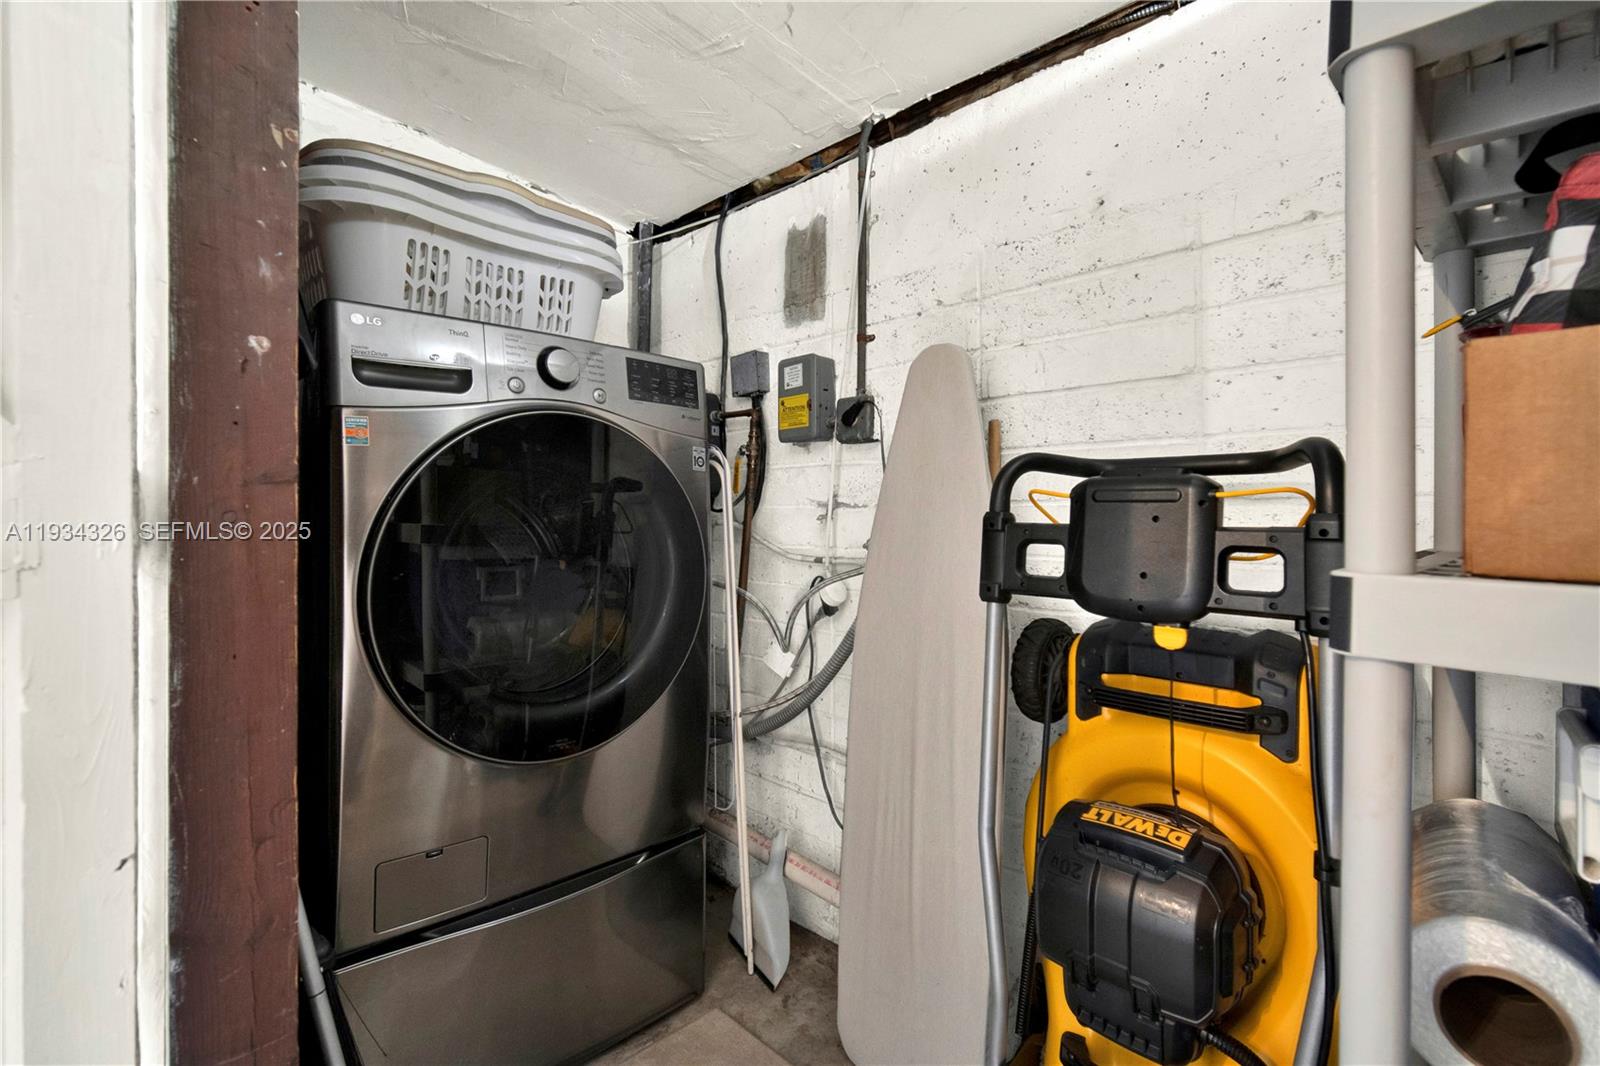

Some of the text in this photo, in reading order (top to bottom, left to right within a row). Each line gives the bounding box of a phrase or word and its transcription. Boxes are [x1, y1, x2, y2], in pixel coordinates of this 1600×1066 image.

[366, 316, 382, 326] LG
[449, 329, 469, 338] ThinQ
[1083, 807, 1192, 848] DEWALT
